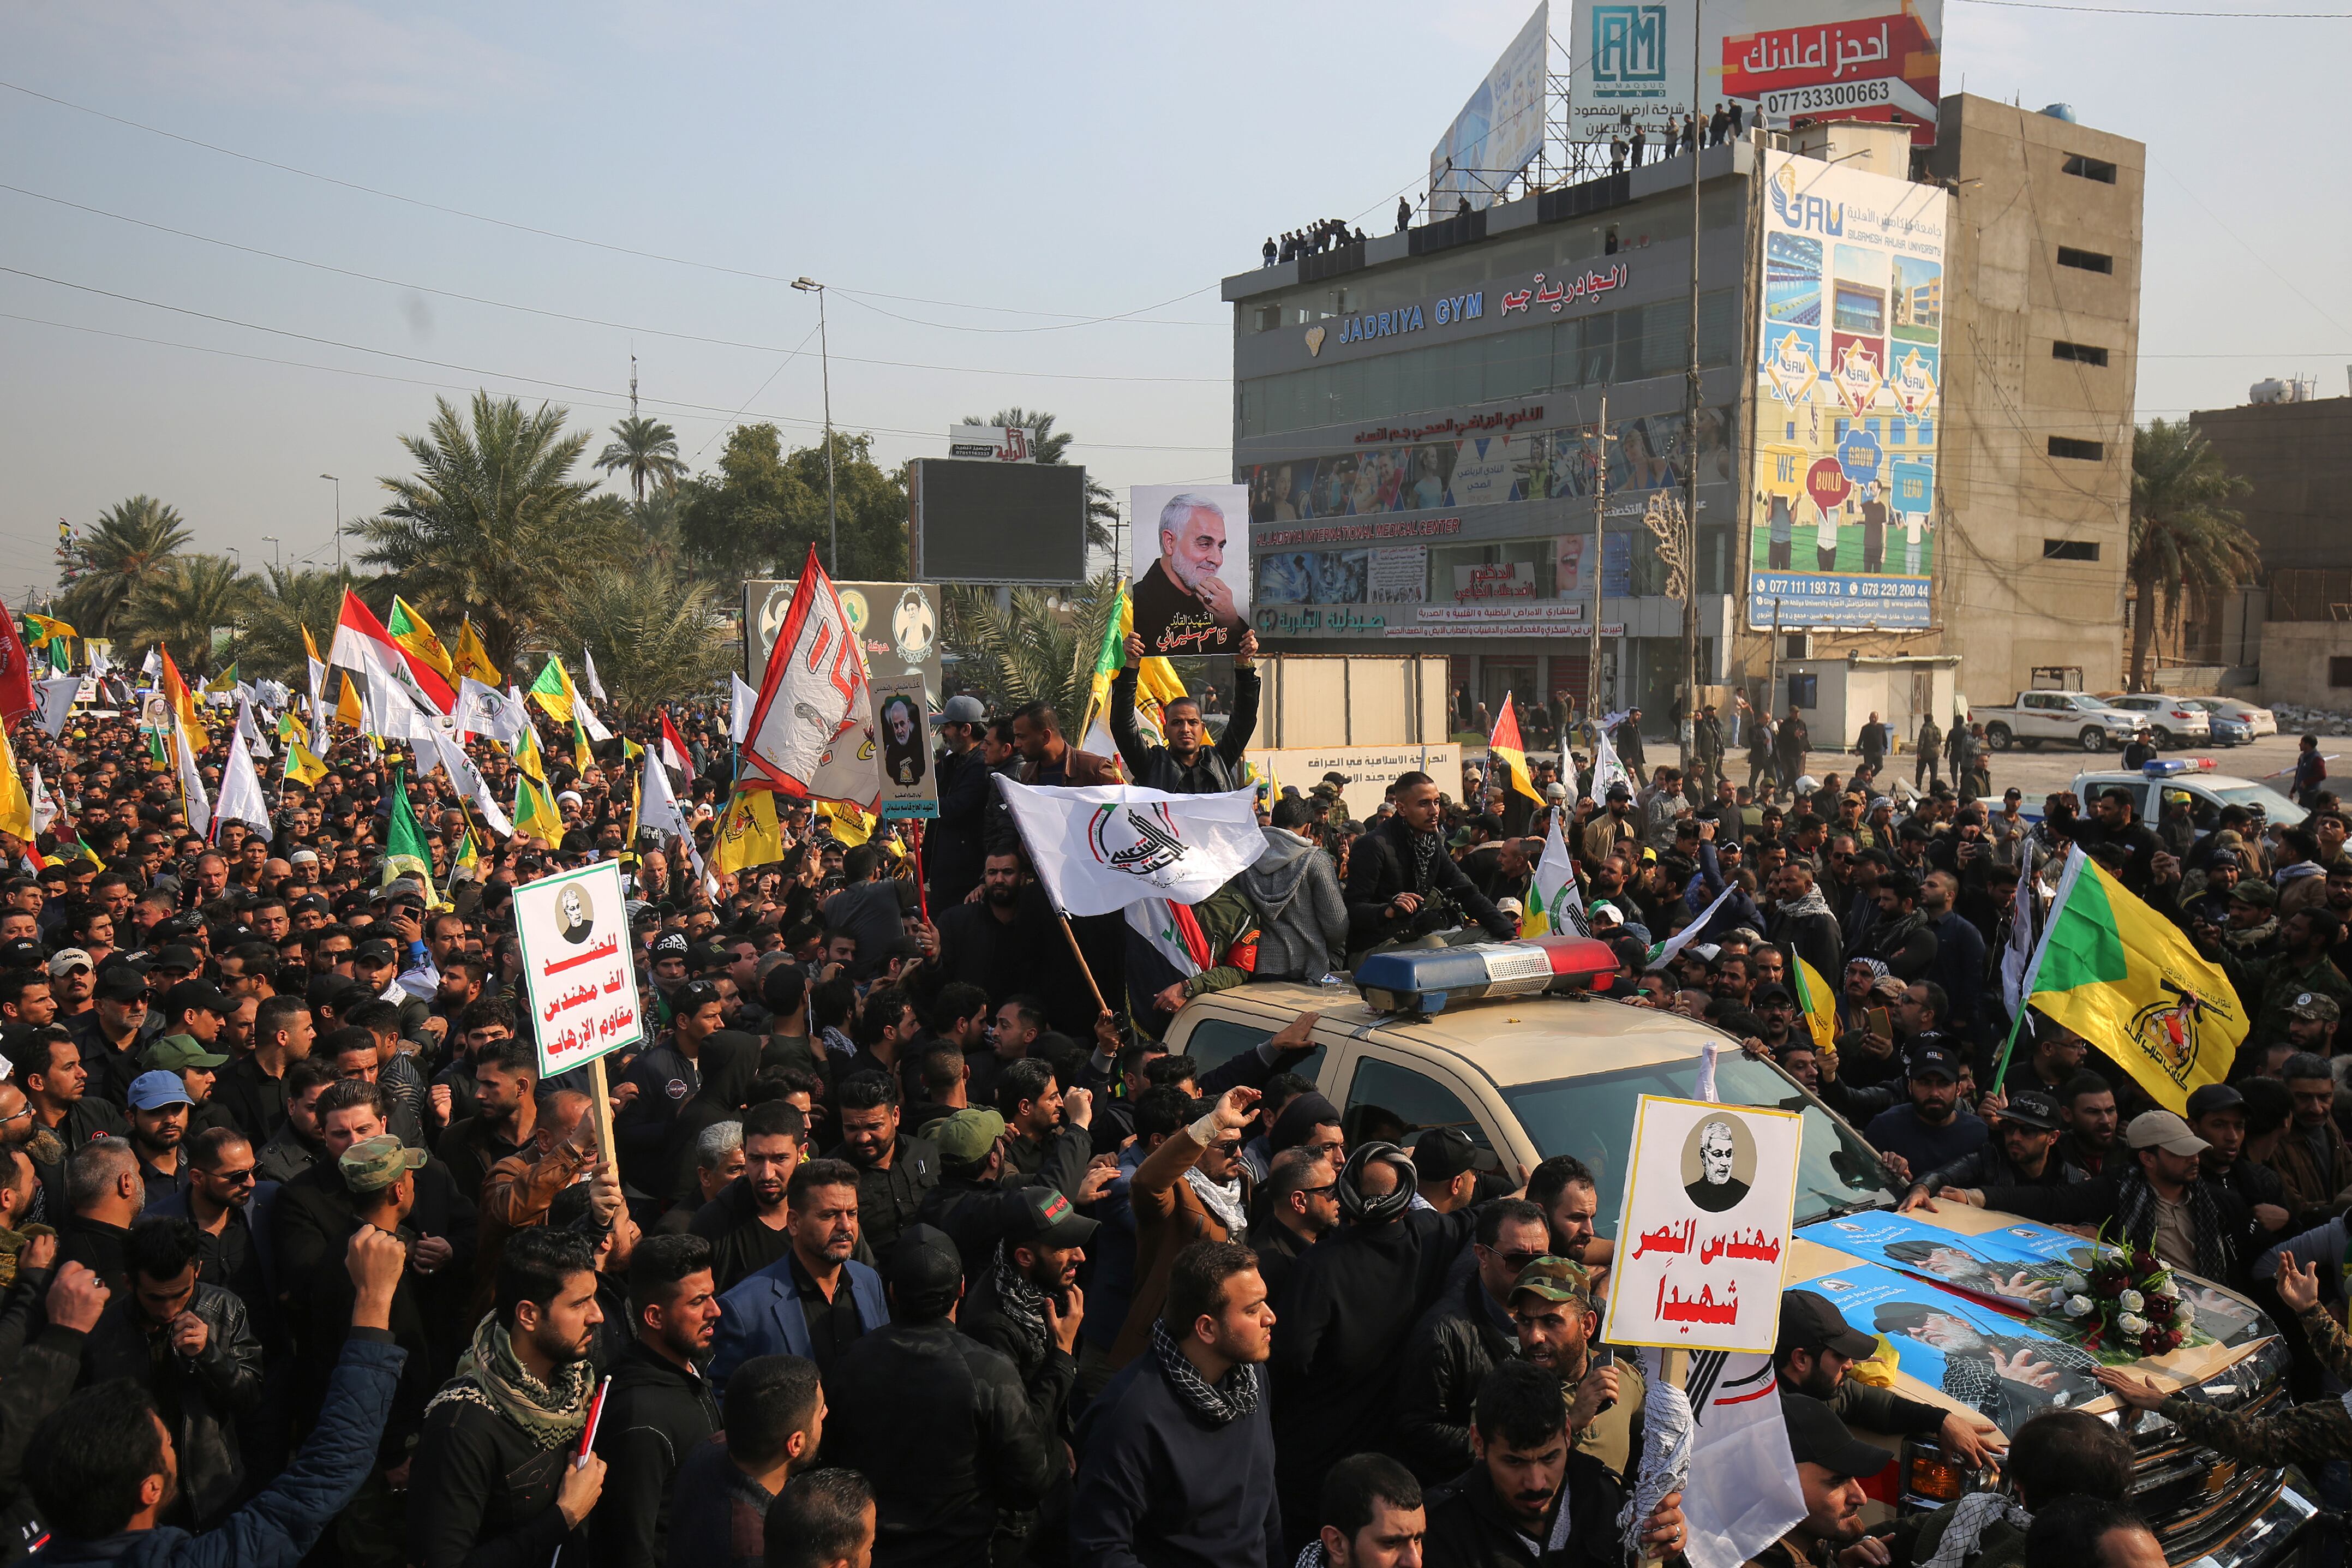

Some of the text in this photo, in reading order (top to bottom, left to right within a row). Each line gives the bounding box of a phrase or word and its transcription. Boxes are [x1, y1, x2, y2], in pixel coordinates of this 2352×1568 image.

[1743, 23, 1888, 77] احجز اعلانك
[1768, 81, 1889, 113] 07733300663
[1575, 104, 1623, 118] المقصود
[1652, 101, 1685, 117] شركة
[1501, 263, 1627, 316] الجادرية جم
[1340, 292, 1483, 344] JADRIYA GYM
[1455, 412, 1503, 436] الرياضي
[1505, 406, 1543, 429] النادي
[1413, 418, 1453, 441] الصحي
[1848, 446, 1874, 467] GROW
[1776, 454, 1795, 483] WE
[1815, 471, 1842, 492] BUILD
[1903, 478, 1923, 499] LEAD
[1256, 517, 1460, 546] AL JADRIYA INTERNATIONAL MEDICAL CENTER
[1470, 563, 1515, 583] الدكتور
[1770, 579, 1928, 597] 077 111 193 73 078 220 200 44
[1279, 608, 1385, 635] صيدلية الجادرية
[1419, 609, 1443, 618] الصدرية
[1485, 608, 1510, 617] الباطنية
[1513, 608, 1542, 618] الامراض
[1546, 607, 1578, 617] استشاري
[1156, 625, 1228, 653] قاسم سليماني
[1545, 625, 1570, 635] السكري
[1571, 626, 1582, 635] في
[1611, 625, 1623, 635] خبير
[867, 639, 890, 655] حركة
[1308, 757, 1344, 769] العراق
[1346, 756, 1362, 768] في
[1365, 754, 1407, 767] الاسلامية
[1365, 772, 1385, 783] جند
[544, 932, 618, 976] للحشد
[544, 968, 624, 1022] الف مهندس
[600, 1006, 633, 1042] مقاوم
[1631, 1218, 1780, 1265] مهندس النصر
